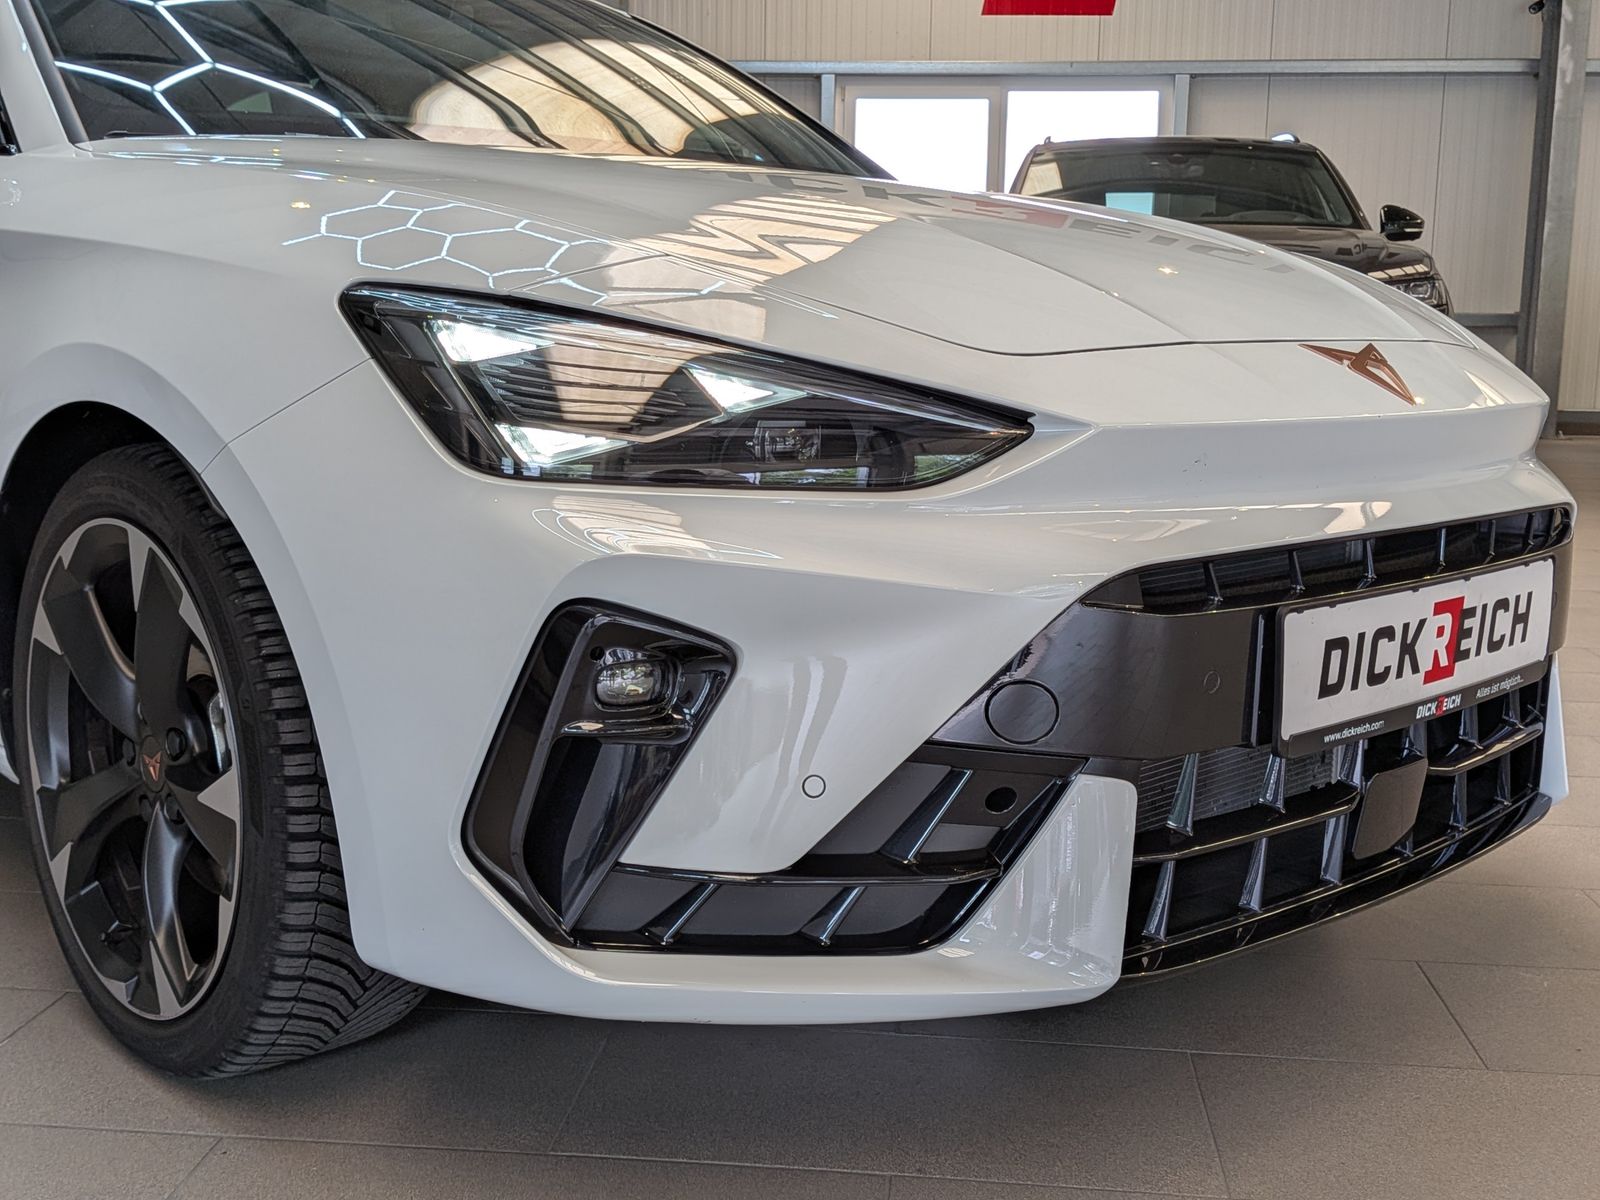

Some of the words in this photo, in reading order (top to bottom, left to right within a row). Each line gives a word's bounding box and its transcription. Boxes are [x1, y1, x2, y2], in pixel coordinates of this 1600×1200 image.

[1317, 591, 1533, 700] DICKREICH
[1475, 686, 1491, 699] Alles
[1491, 682, 1500, 694] ist
[1416, 693, 1462, 719] DICKREICH
[1323, 720, 1385, 743] www.dickreich.com
